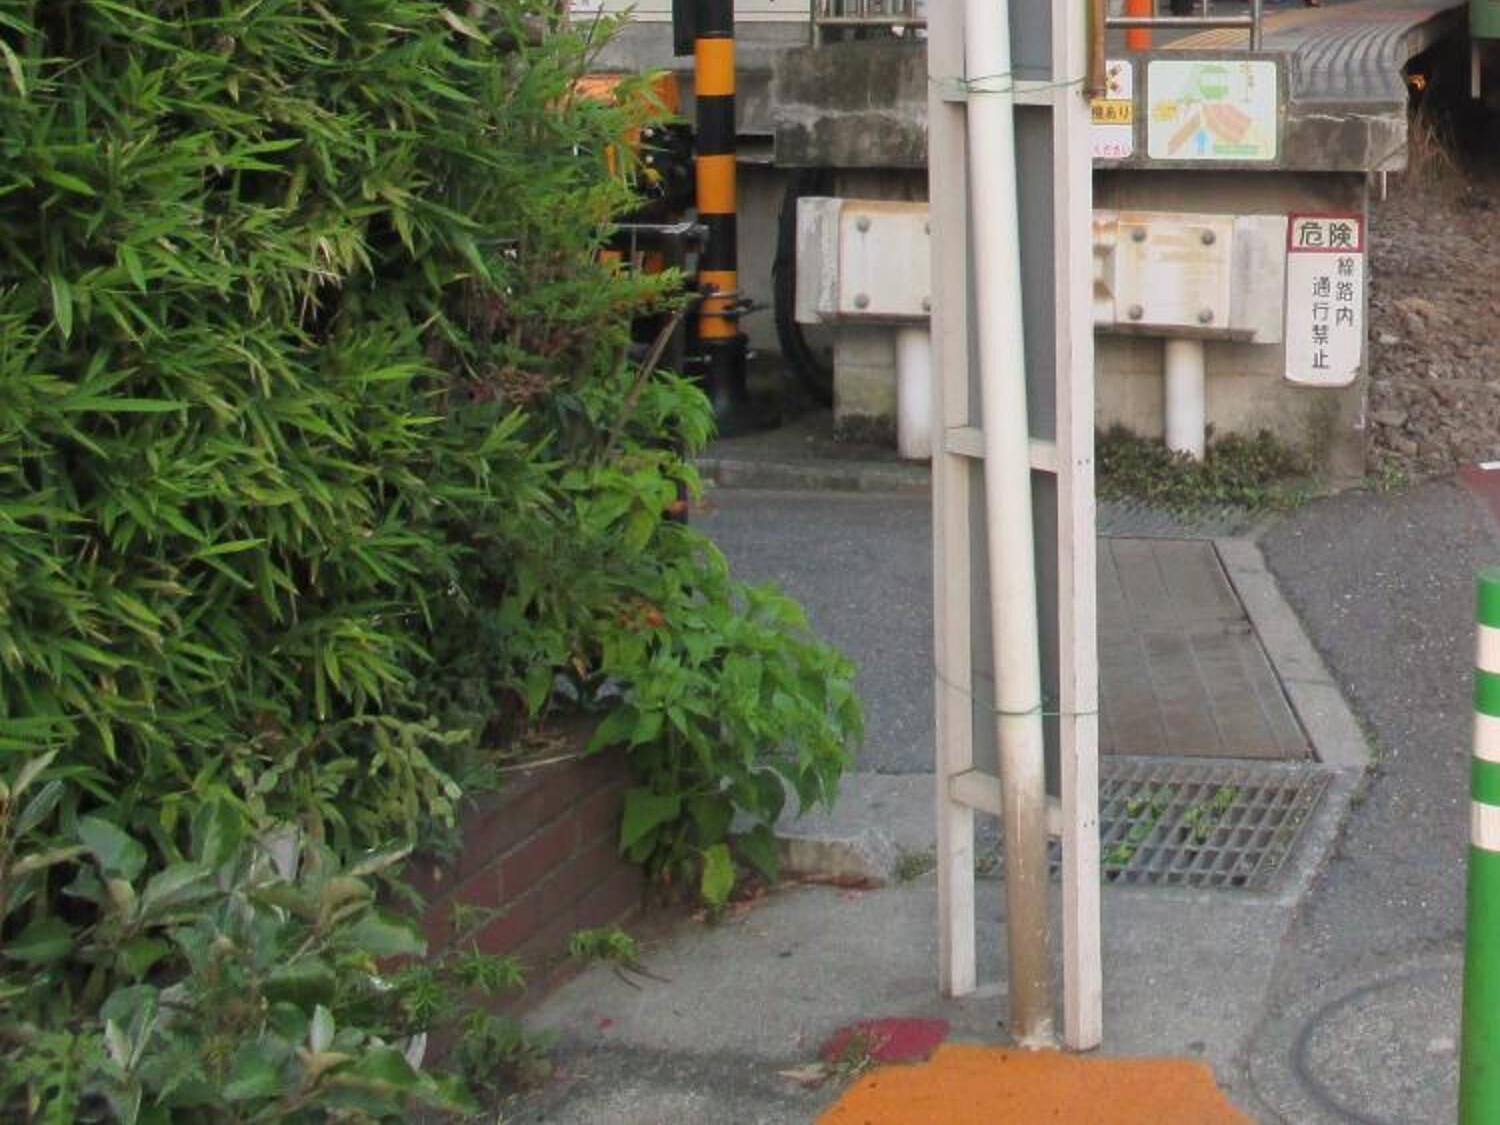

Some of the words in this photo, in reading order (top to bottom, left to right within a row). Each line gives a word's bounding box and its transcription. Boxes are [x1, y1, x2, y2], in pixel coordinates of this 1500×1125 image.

[1299, 222, 1353, 247] 危険
[1311, 276, 1331, 369] 通行禁止
[1335, 257, 1354, 327] 線路内
